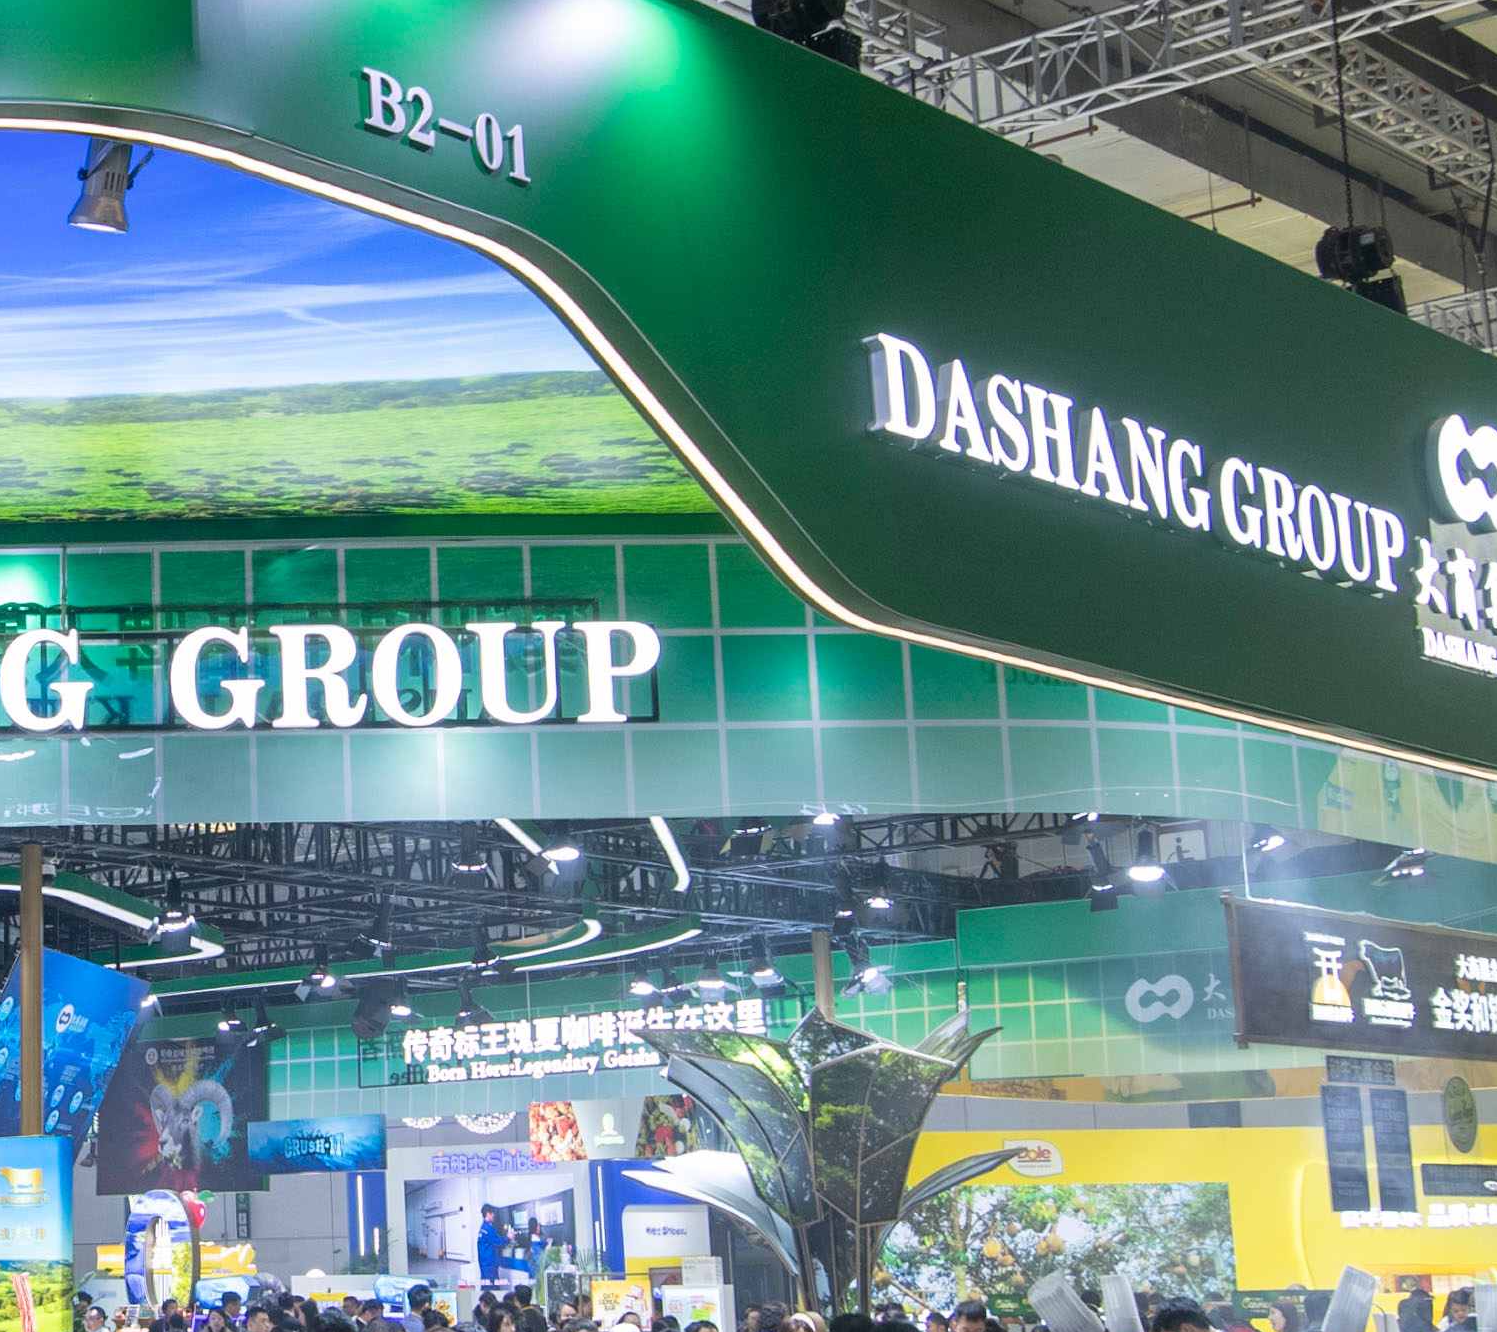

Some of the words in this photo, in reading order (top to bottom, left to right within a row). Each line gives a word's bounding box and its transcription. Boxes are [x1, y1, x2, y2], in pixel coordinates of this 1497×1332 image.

[360, 67, 532, 187] B2-01
[864, 333, 1212, 533] DASHANG
[1218, 456, 1405, 595] GROUP
[169, 619, 662, 731] GROUP
[1422, 629, 1495, 678] DASHANG
